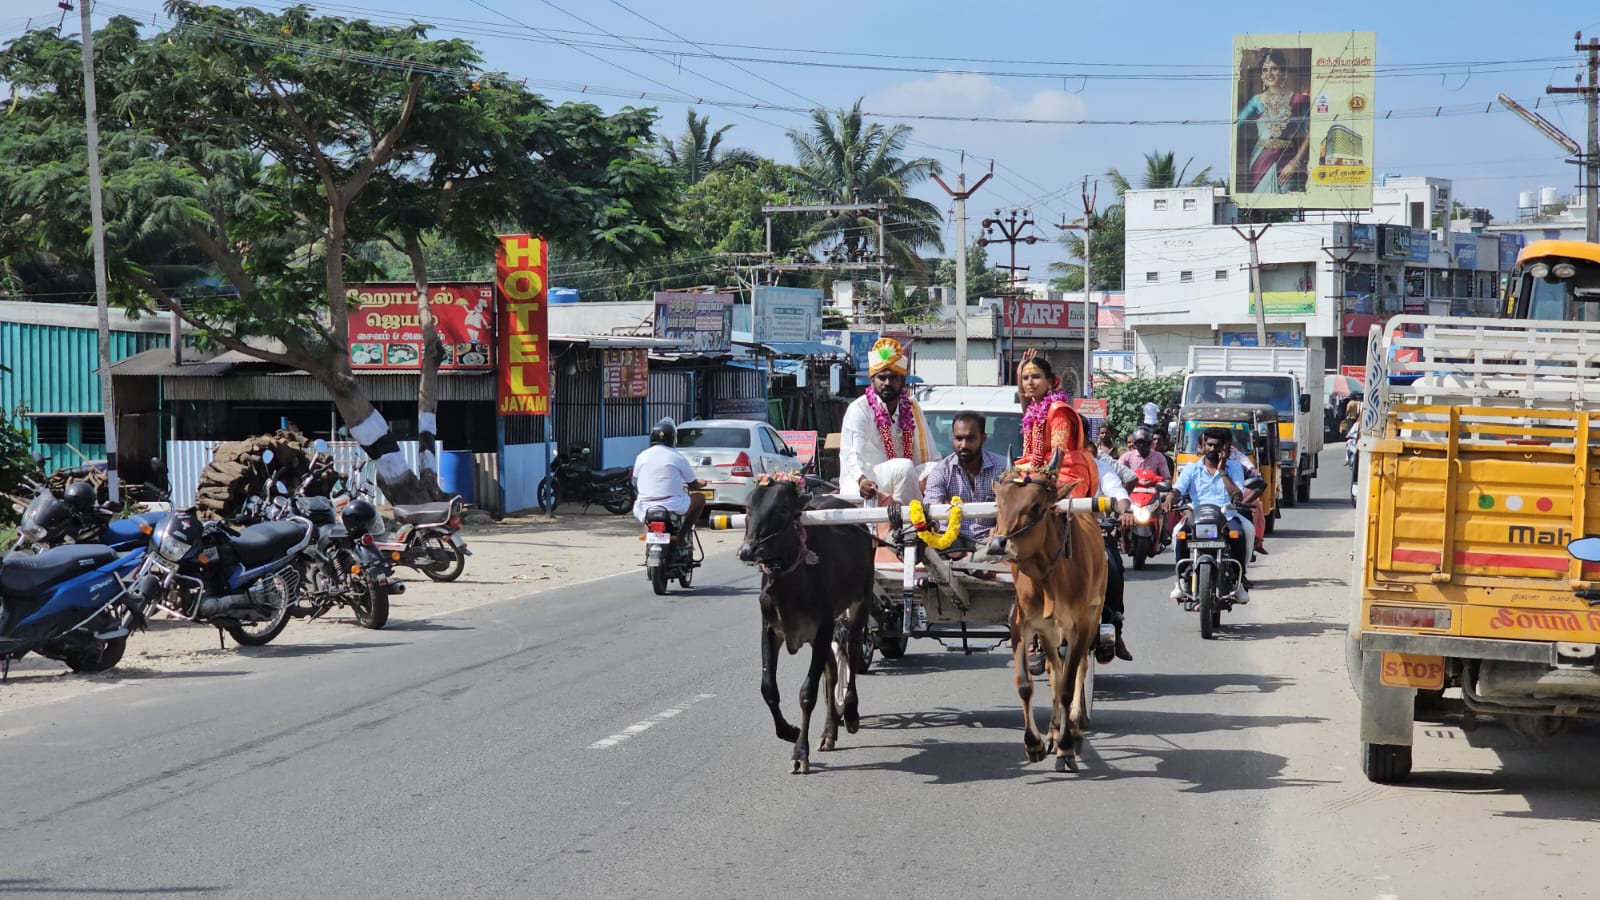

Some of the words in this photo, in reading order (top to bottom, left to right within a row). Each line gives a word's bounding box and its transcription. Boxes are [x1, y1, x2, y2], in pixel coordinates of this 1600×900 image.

[345, 286, 454, 310] ஹோட்ல்
[366, 312, 439, 329] ஜெய
[504, 239, 542, 394] HOTEL
[1022, 303, 1064, 324] MRF
[501, 396, 547, 412] JAYAM
[1508, 525, 1572, 546] Mah
[1490, 608, 1583, 632] Sound
[1385, 661, 1443, 679] STOP
